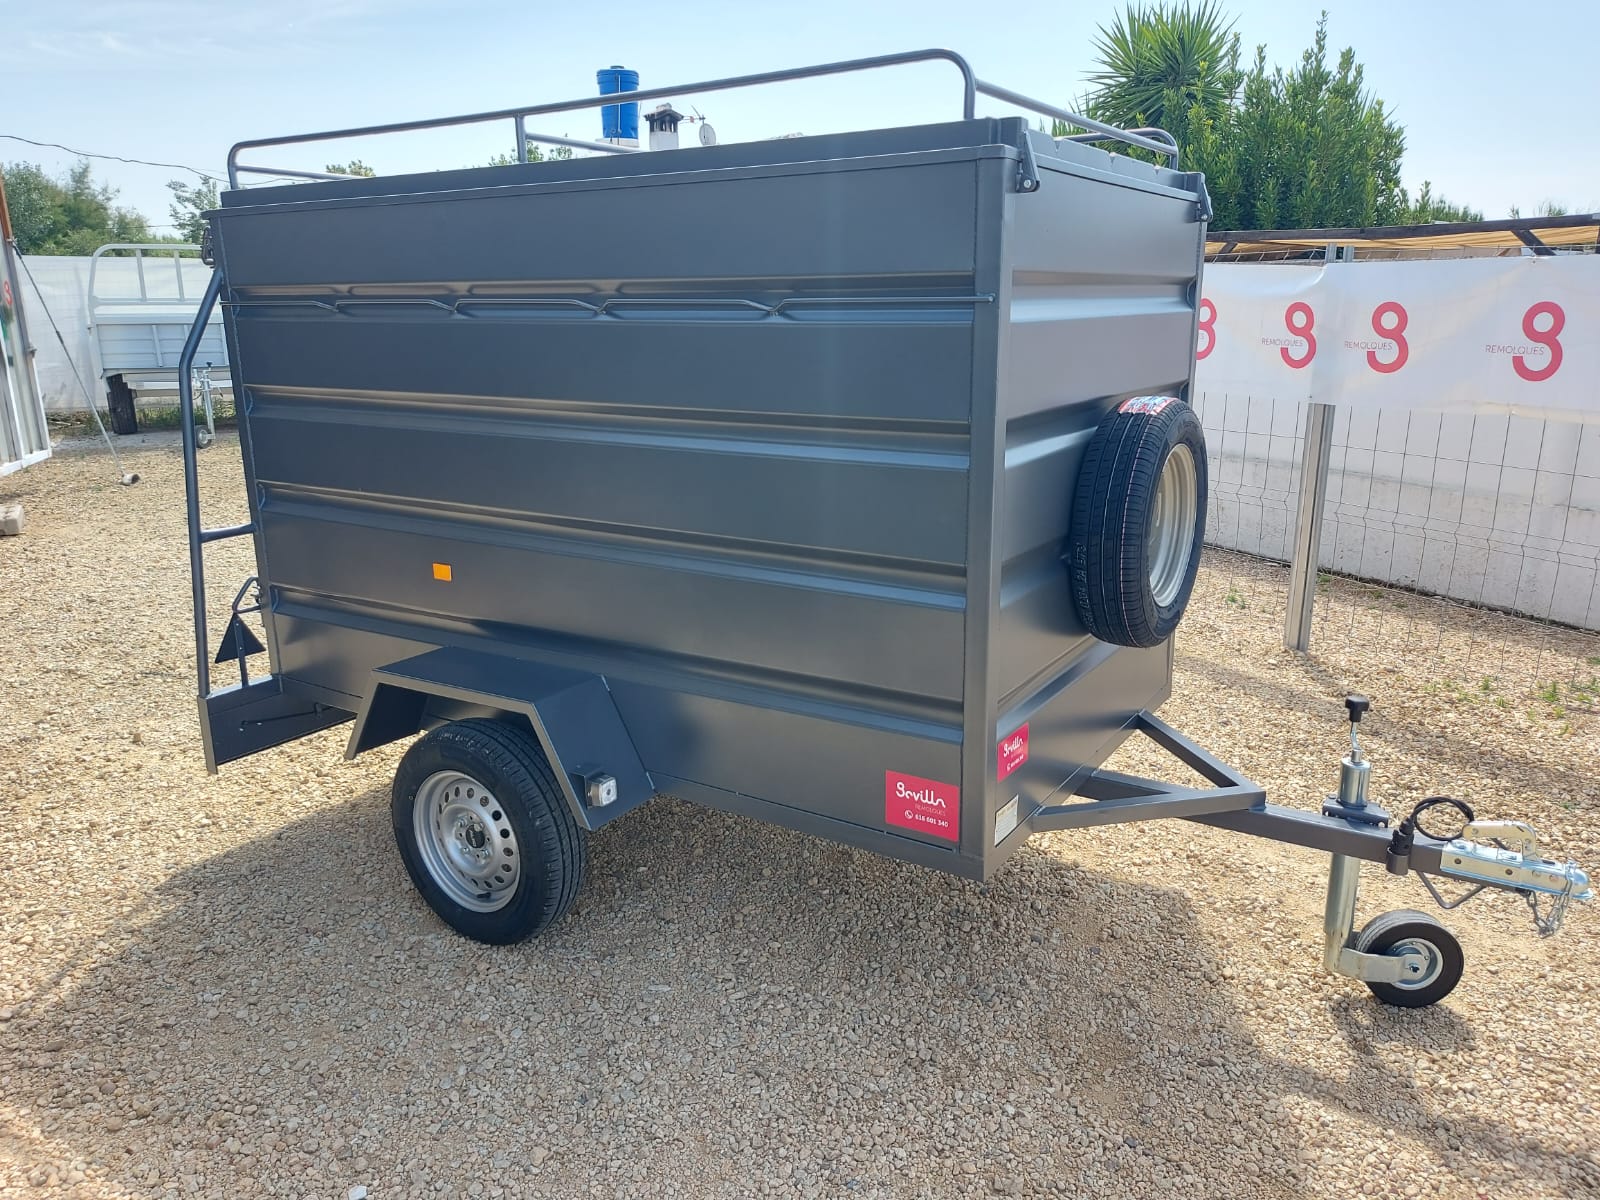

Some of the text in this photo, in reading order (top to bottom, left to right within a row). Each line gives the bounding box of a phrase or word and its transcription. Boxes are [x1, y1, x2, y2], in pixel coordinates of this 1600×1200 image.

[1261, 338, 1304, 347] REMOLQUES
[1344, 340, 1393, 351] REMOLQUES
[1485, 344, 1545, 356] REMOLQUES
[938, 819, 949, 828] 340
